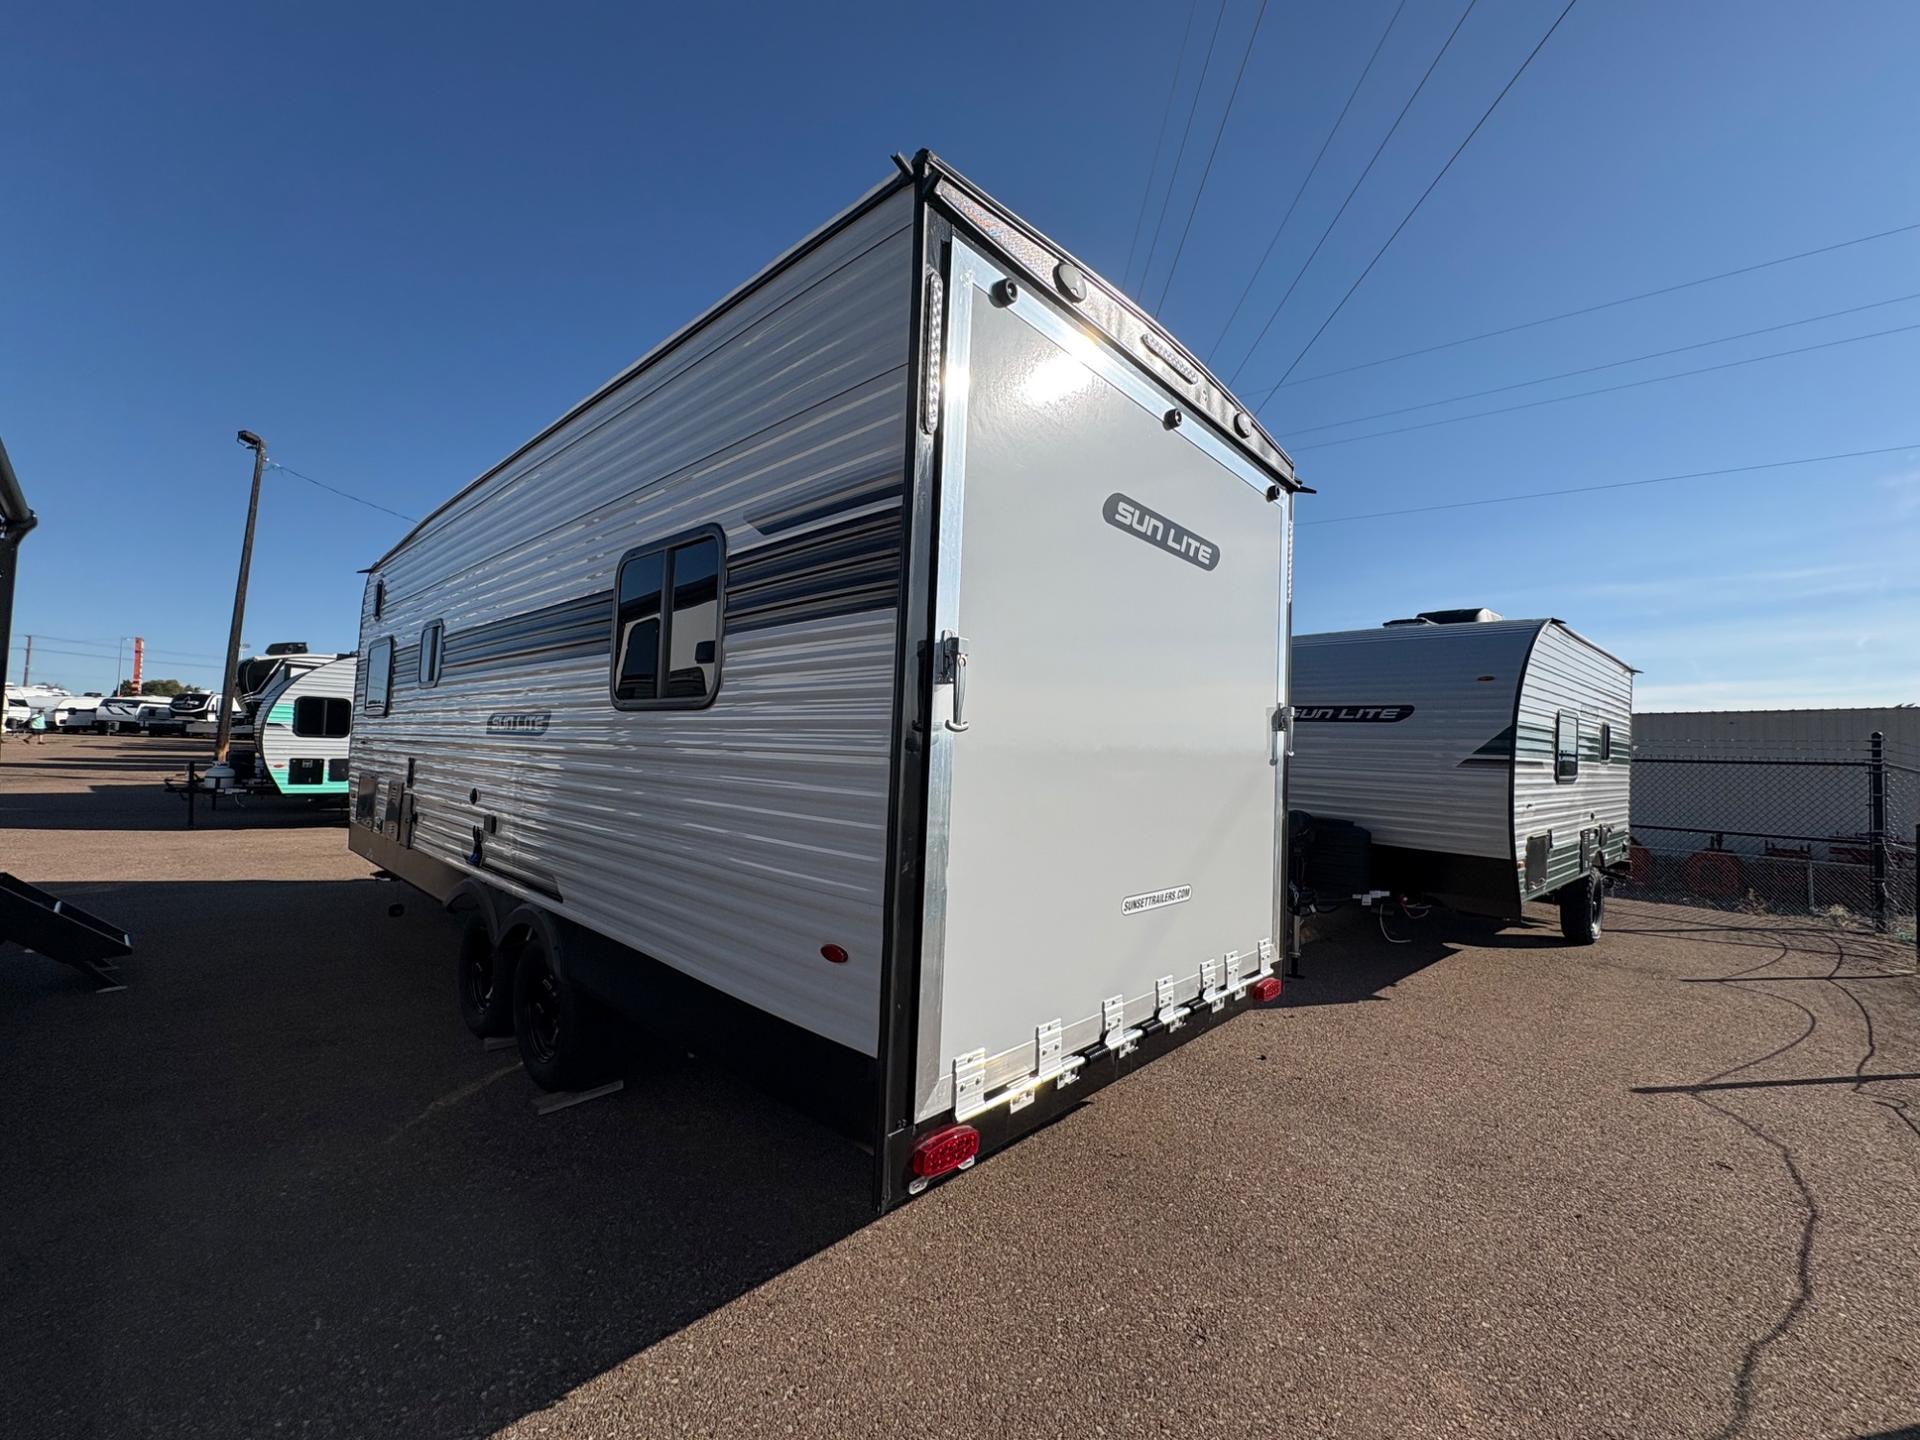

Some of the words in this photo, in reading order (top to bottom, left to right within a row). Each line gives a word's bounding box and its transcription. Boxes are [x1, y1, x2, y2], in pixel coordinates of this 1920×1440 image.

[1115, 501, 1163, 541] SUN
[1166, 528, 1212, 565] LITE
[1294, 708, 1334, 719] SUN
[1338, 708, 1400, 719] LITE
[1123, 887, 1190, 912] SUNSETTRAILERS.COM
